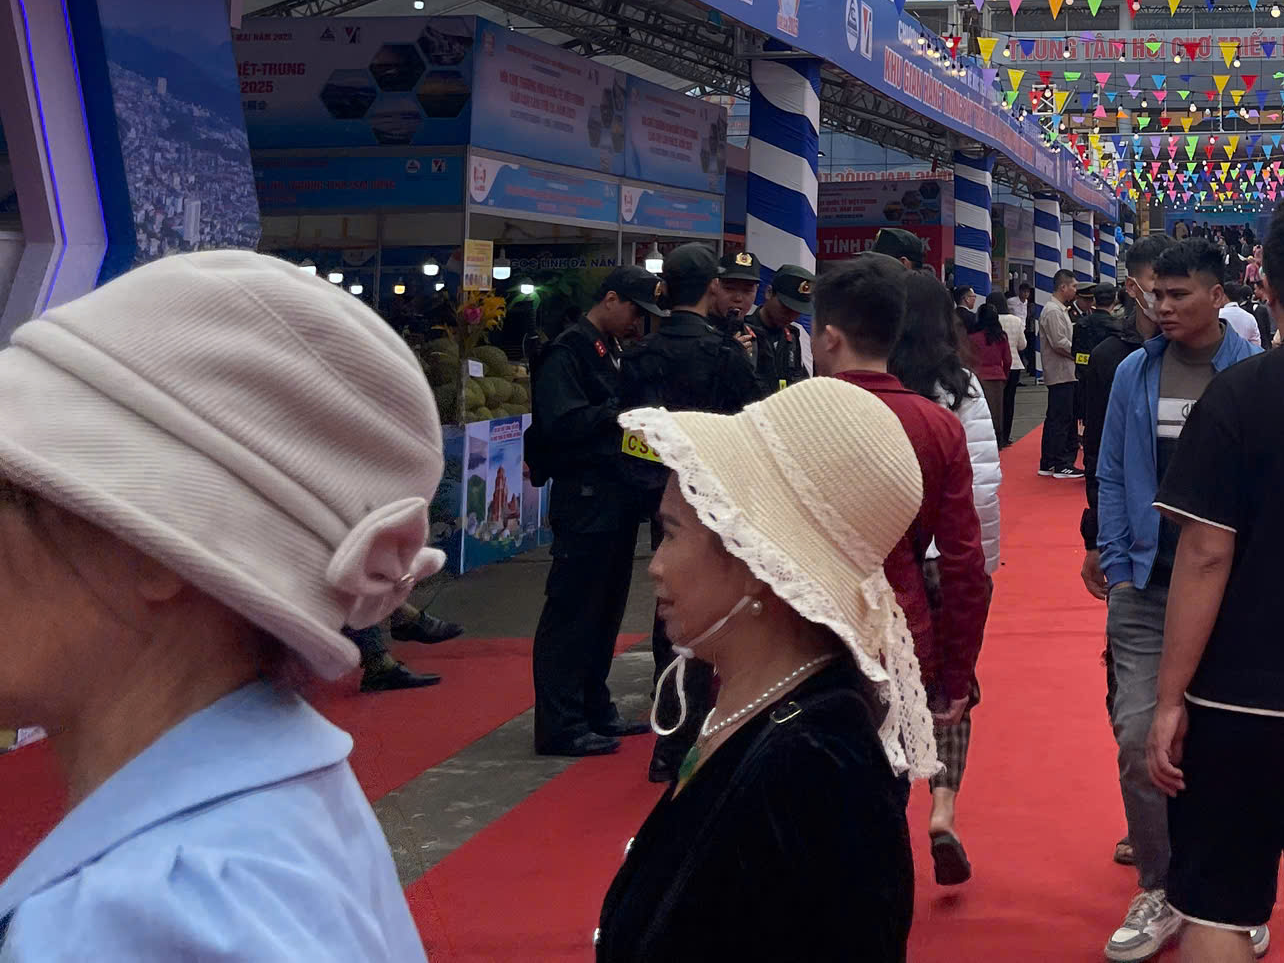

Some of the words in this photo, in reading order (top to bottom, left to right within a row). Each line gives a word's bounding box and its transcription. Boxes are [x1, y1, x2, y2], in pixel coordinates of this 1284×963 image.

[1007, 36, 1078, 61] TUNG
[1171, 34, 1212, 63] CỢ
[238, 60, 305, 77] IỆT-TRUNG
[883, 45, 903, 90] KHU
[240, 80, 273, 95] 2025
[627, 434, 661, 458] CS
